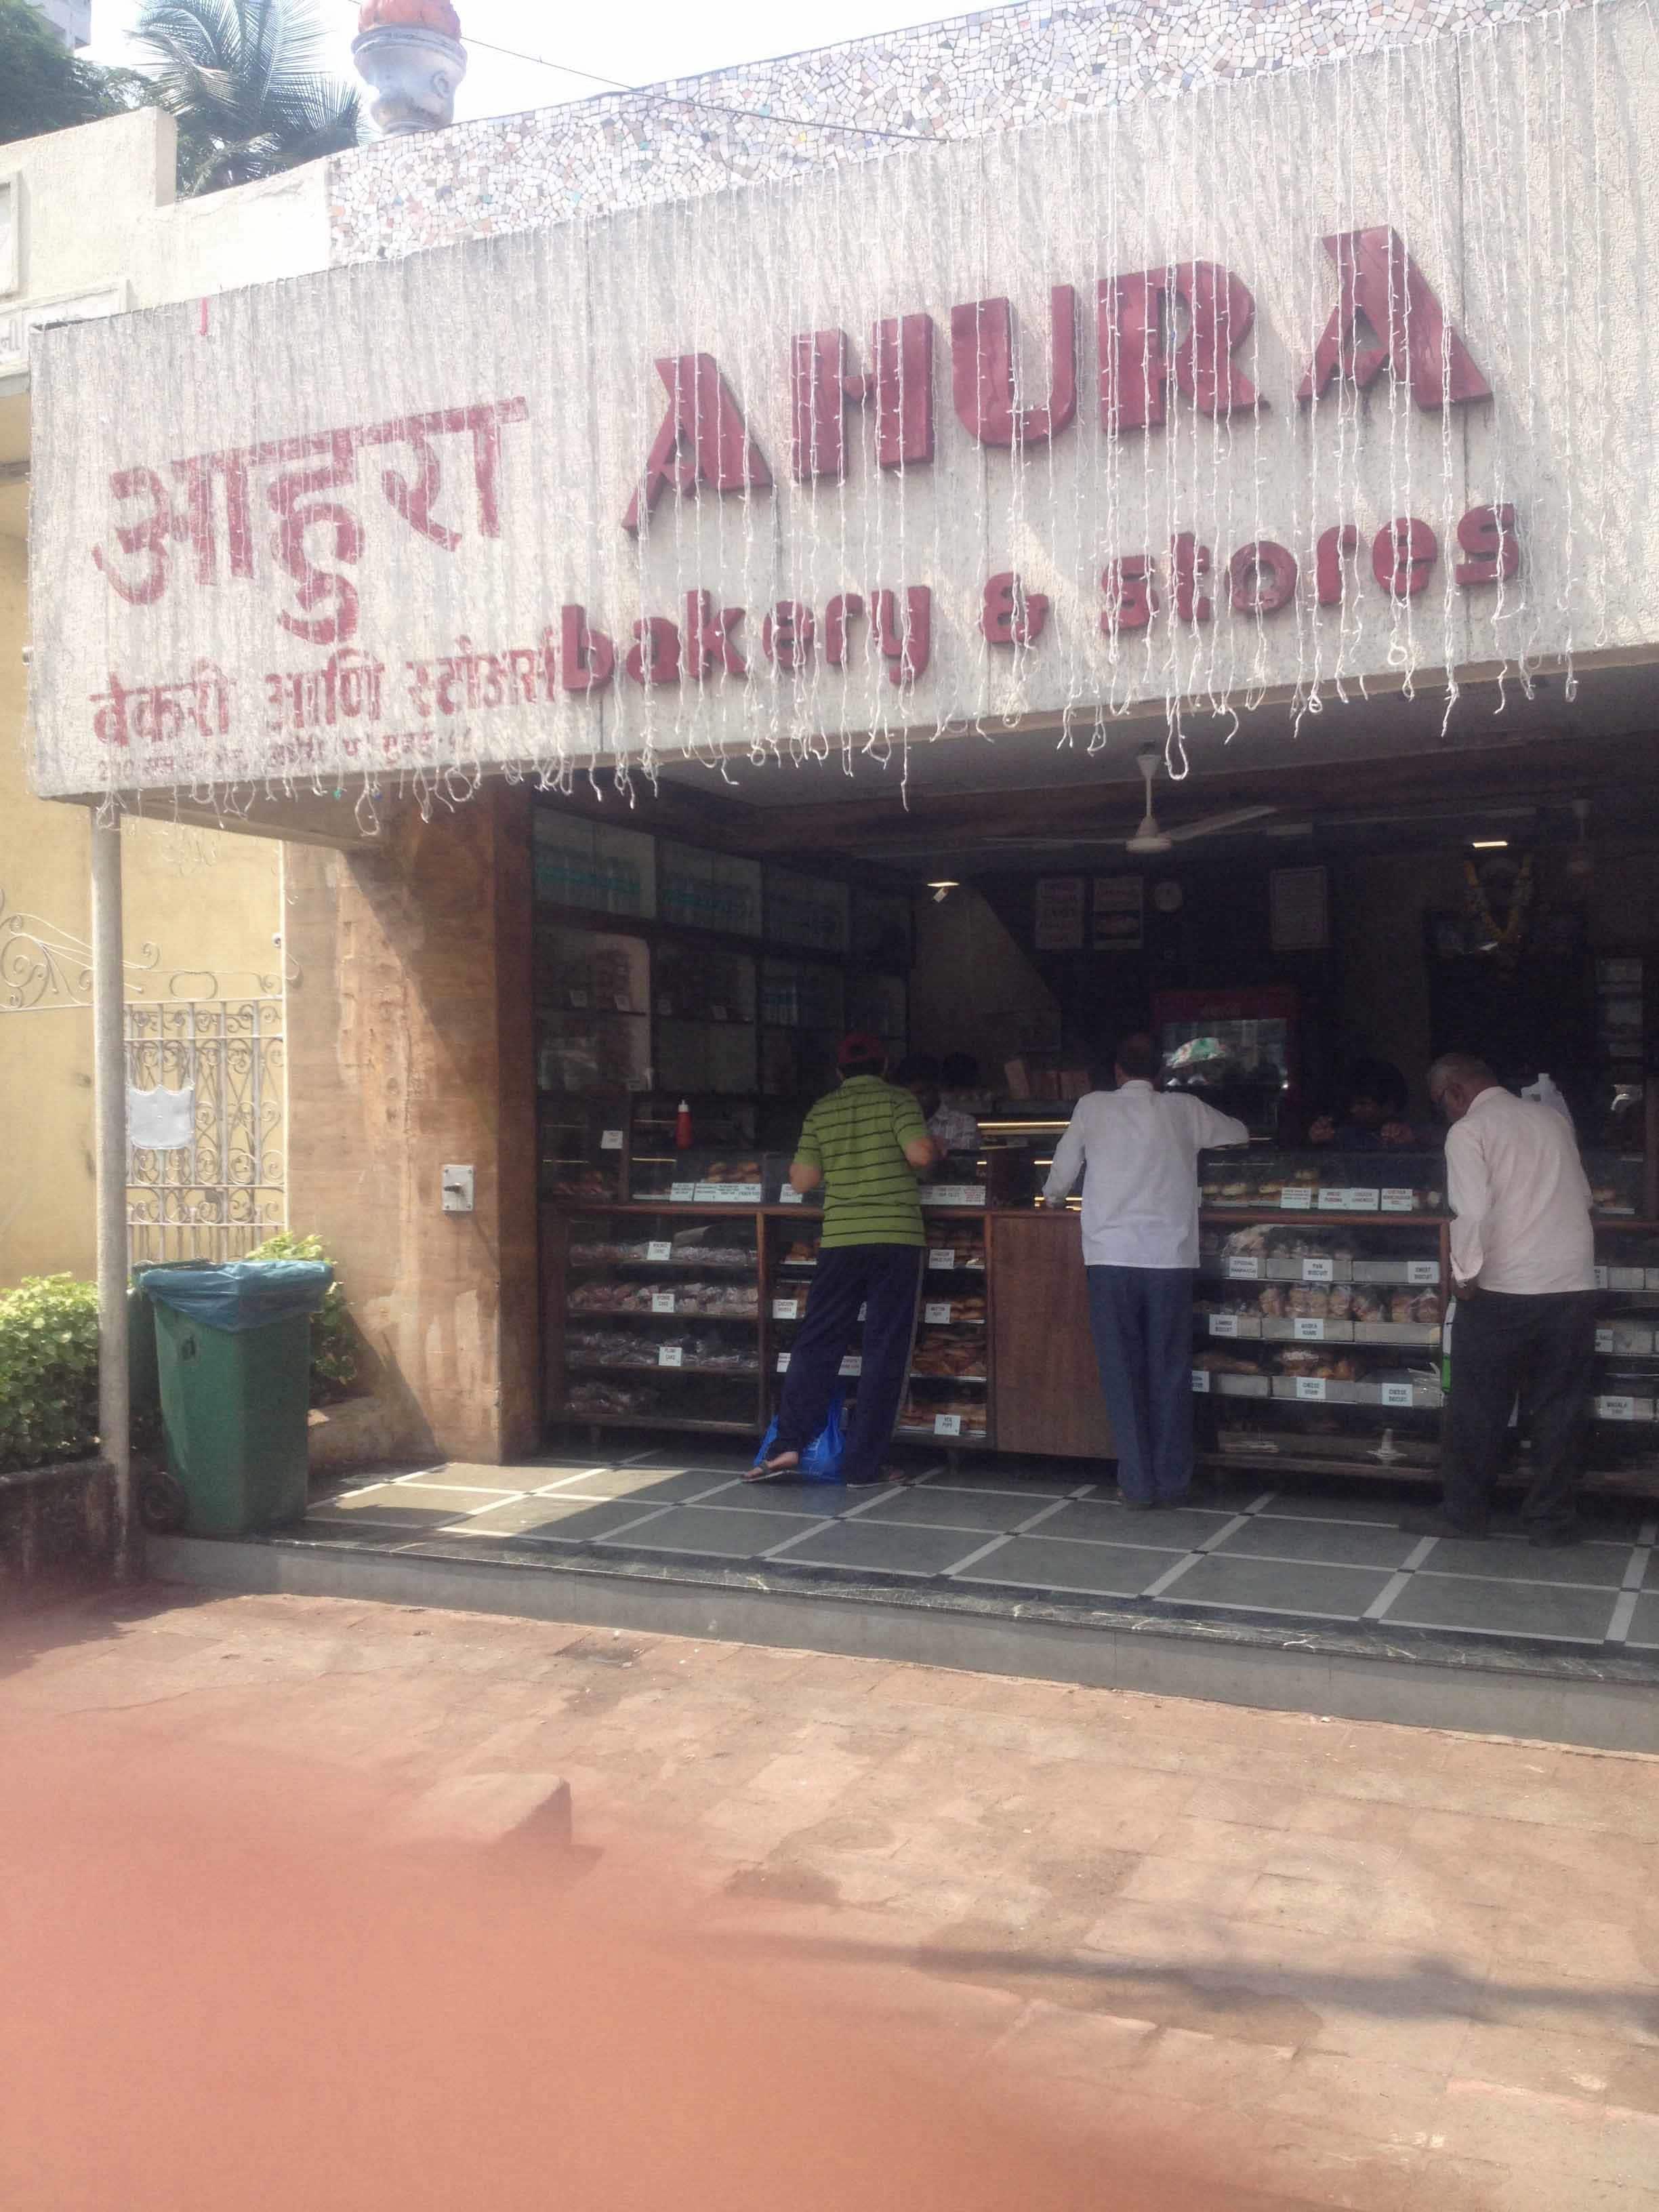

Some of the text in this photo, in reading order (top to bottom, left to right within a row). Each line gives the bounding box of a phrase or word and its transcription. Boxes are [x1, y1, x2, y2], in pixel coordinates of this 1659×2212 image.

[621, 226, 1493, 534] AHURA
[91, 396, 529, 645] आहुरा
[562, 503, 1520, 693] bakery & stores
